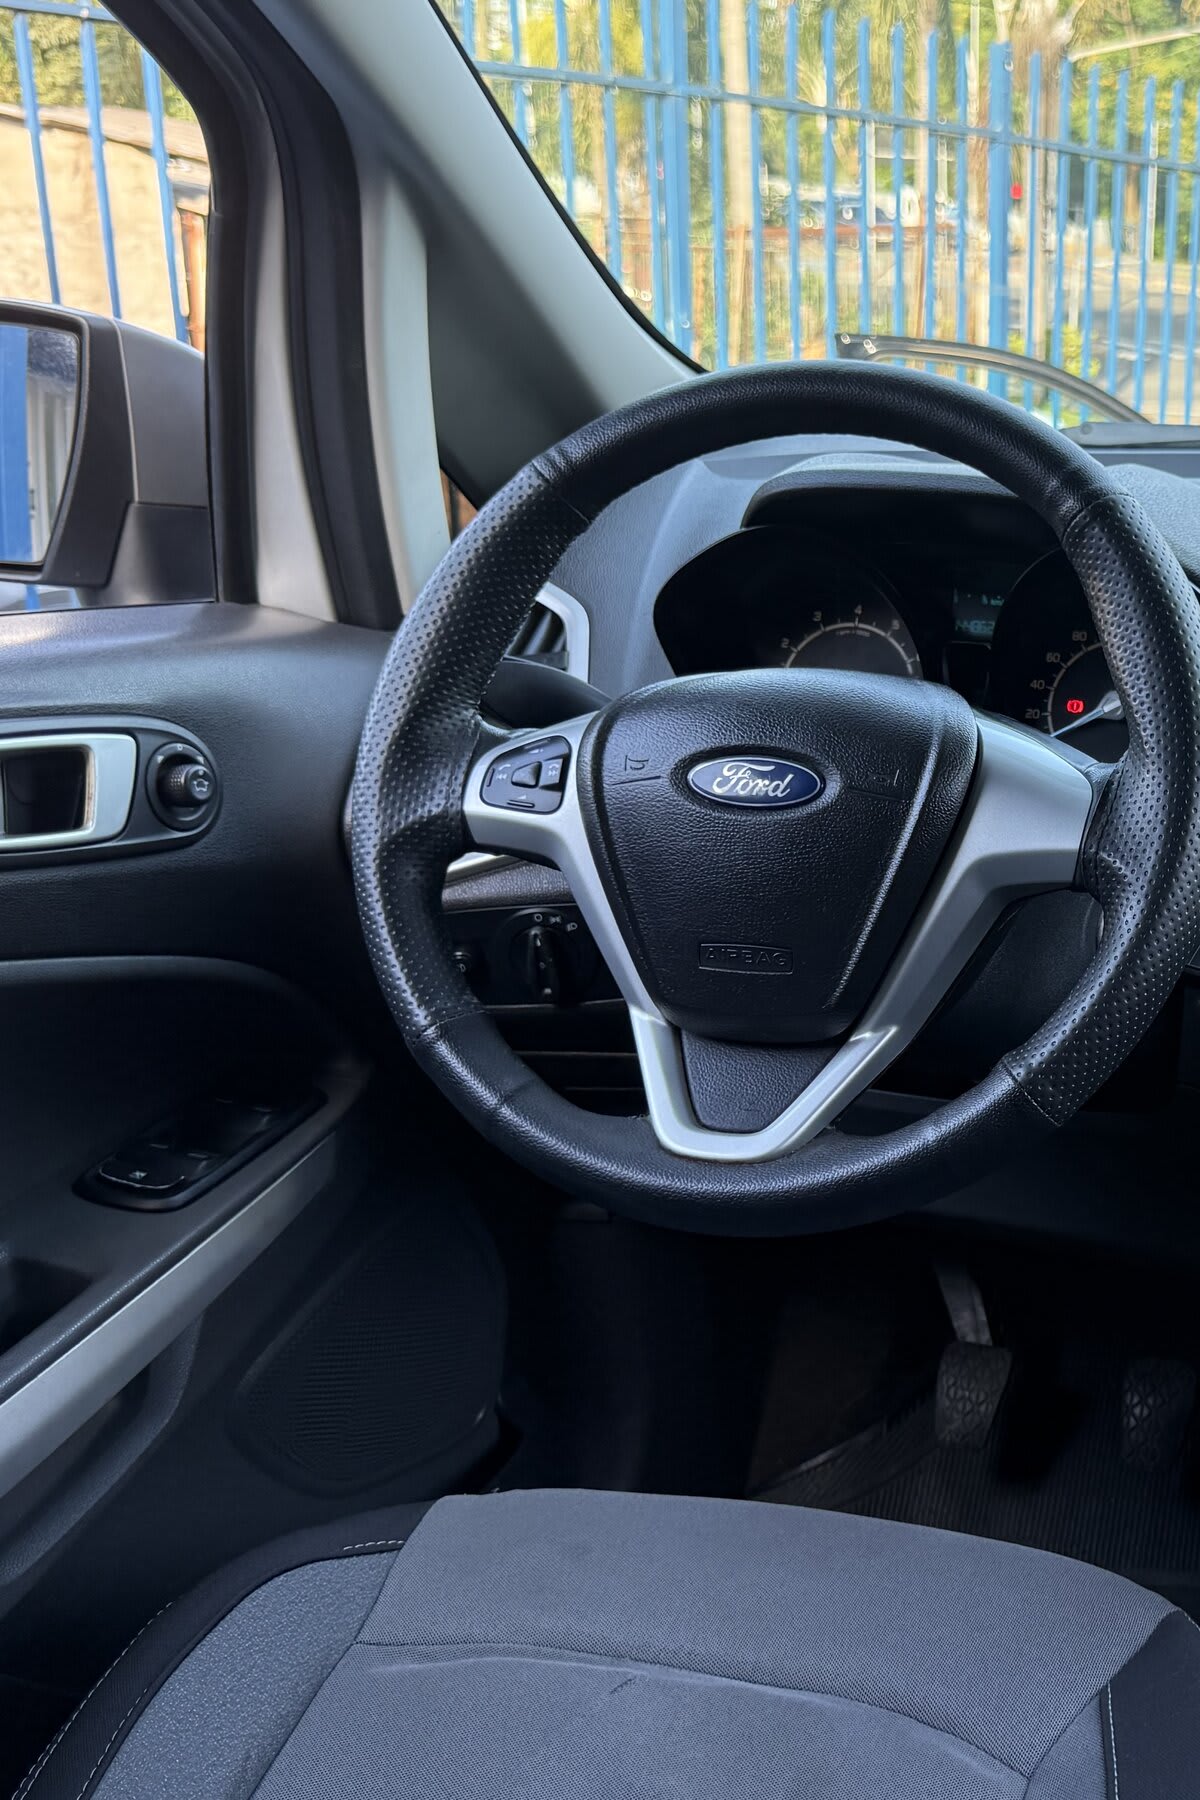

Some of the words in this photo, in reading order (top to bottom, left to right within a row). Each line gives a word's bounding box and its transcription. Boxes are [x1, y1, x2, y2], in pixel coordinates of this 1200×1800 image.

[813, 611, 822, 622] 3
[1071, 631, 1088, 641] 80
[1046, 652, 1061, 663] 60
[1030, 679, 1046, 690] 40
[1025, 708, 1040, 719] 20
[712, 761, 795, 798] Ford
